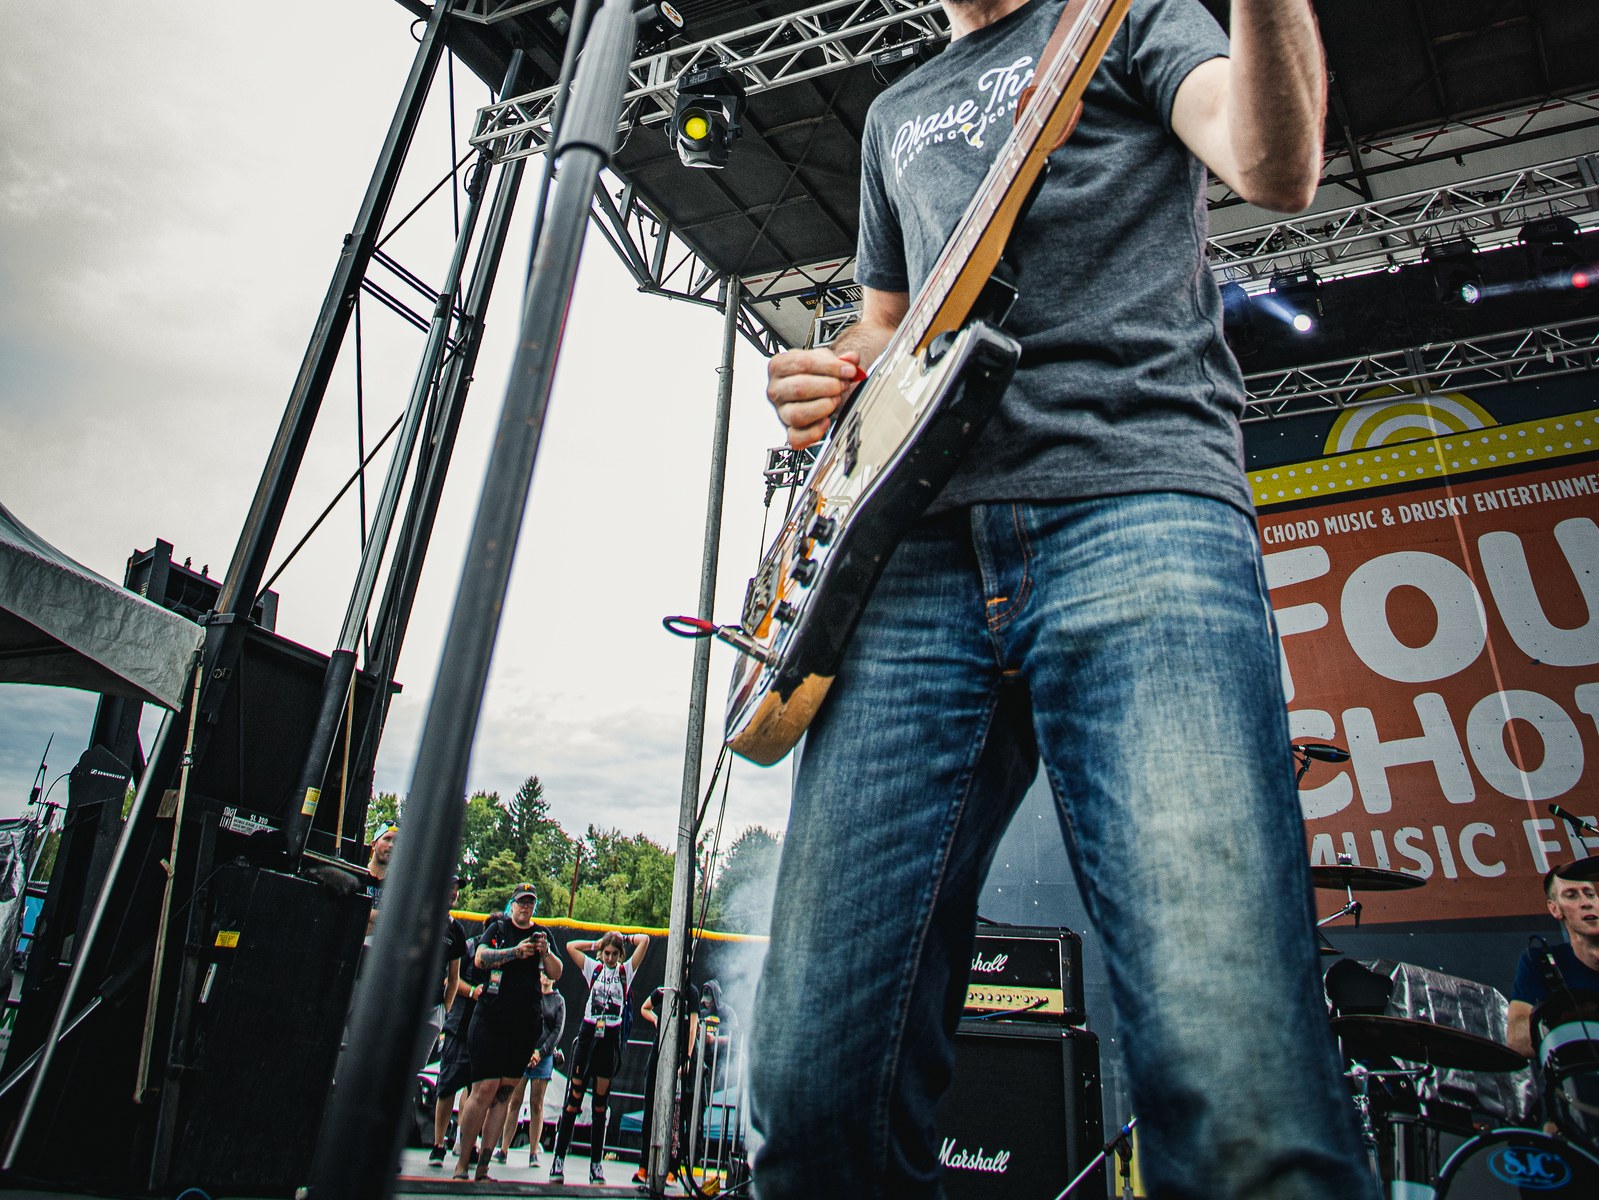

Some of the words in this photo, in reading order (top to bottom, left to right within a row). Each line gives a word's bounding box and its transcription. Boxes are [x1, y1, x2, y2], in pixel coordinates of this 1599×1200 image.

[891, 99, 979, 185] Phase
[1263, 520, 1320, 545] CHORD
[1323, 510, 1378, 536] MUSIC
[1381, 507, 1396, 526] &
[1398, 495, 1469, 524] DRUSKY
[1287, 682, 1599, 820] CHO
[938, 1136, 1011, 1174] Marshall
[1503, 1149, 1556, 1179] SJC
